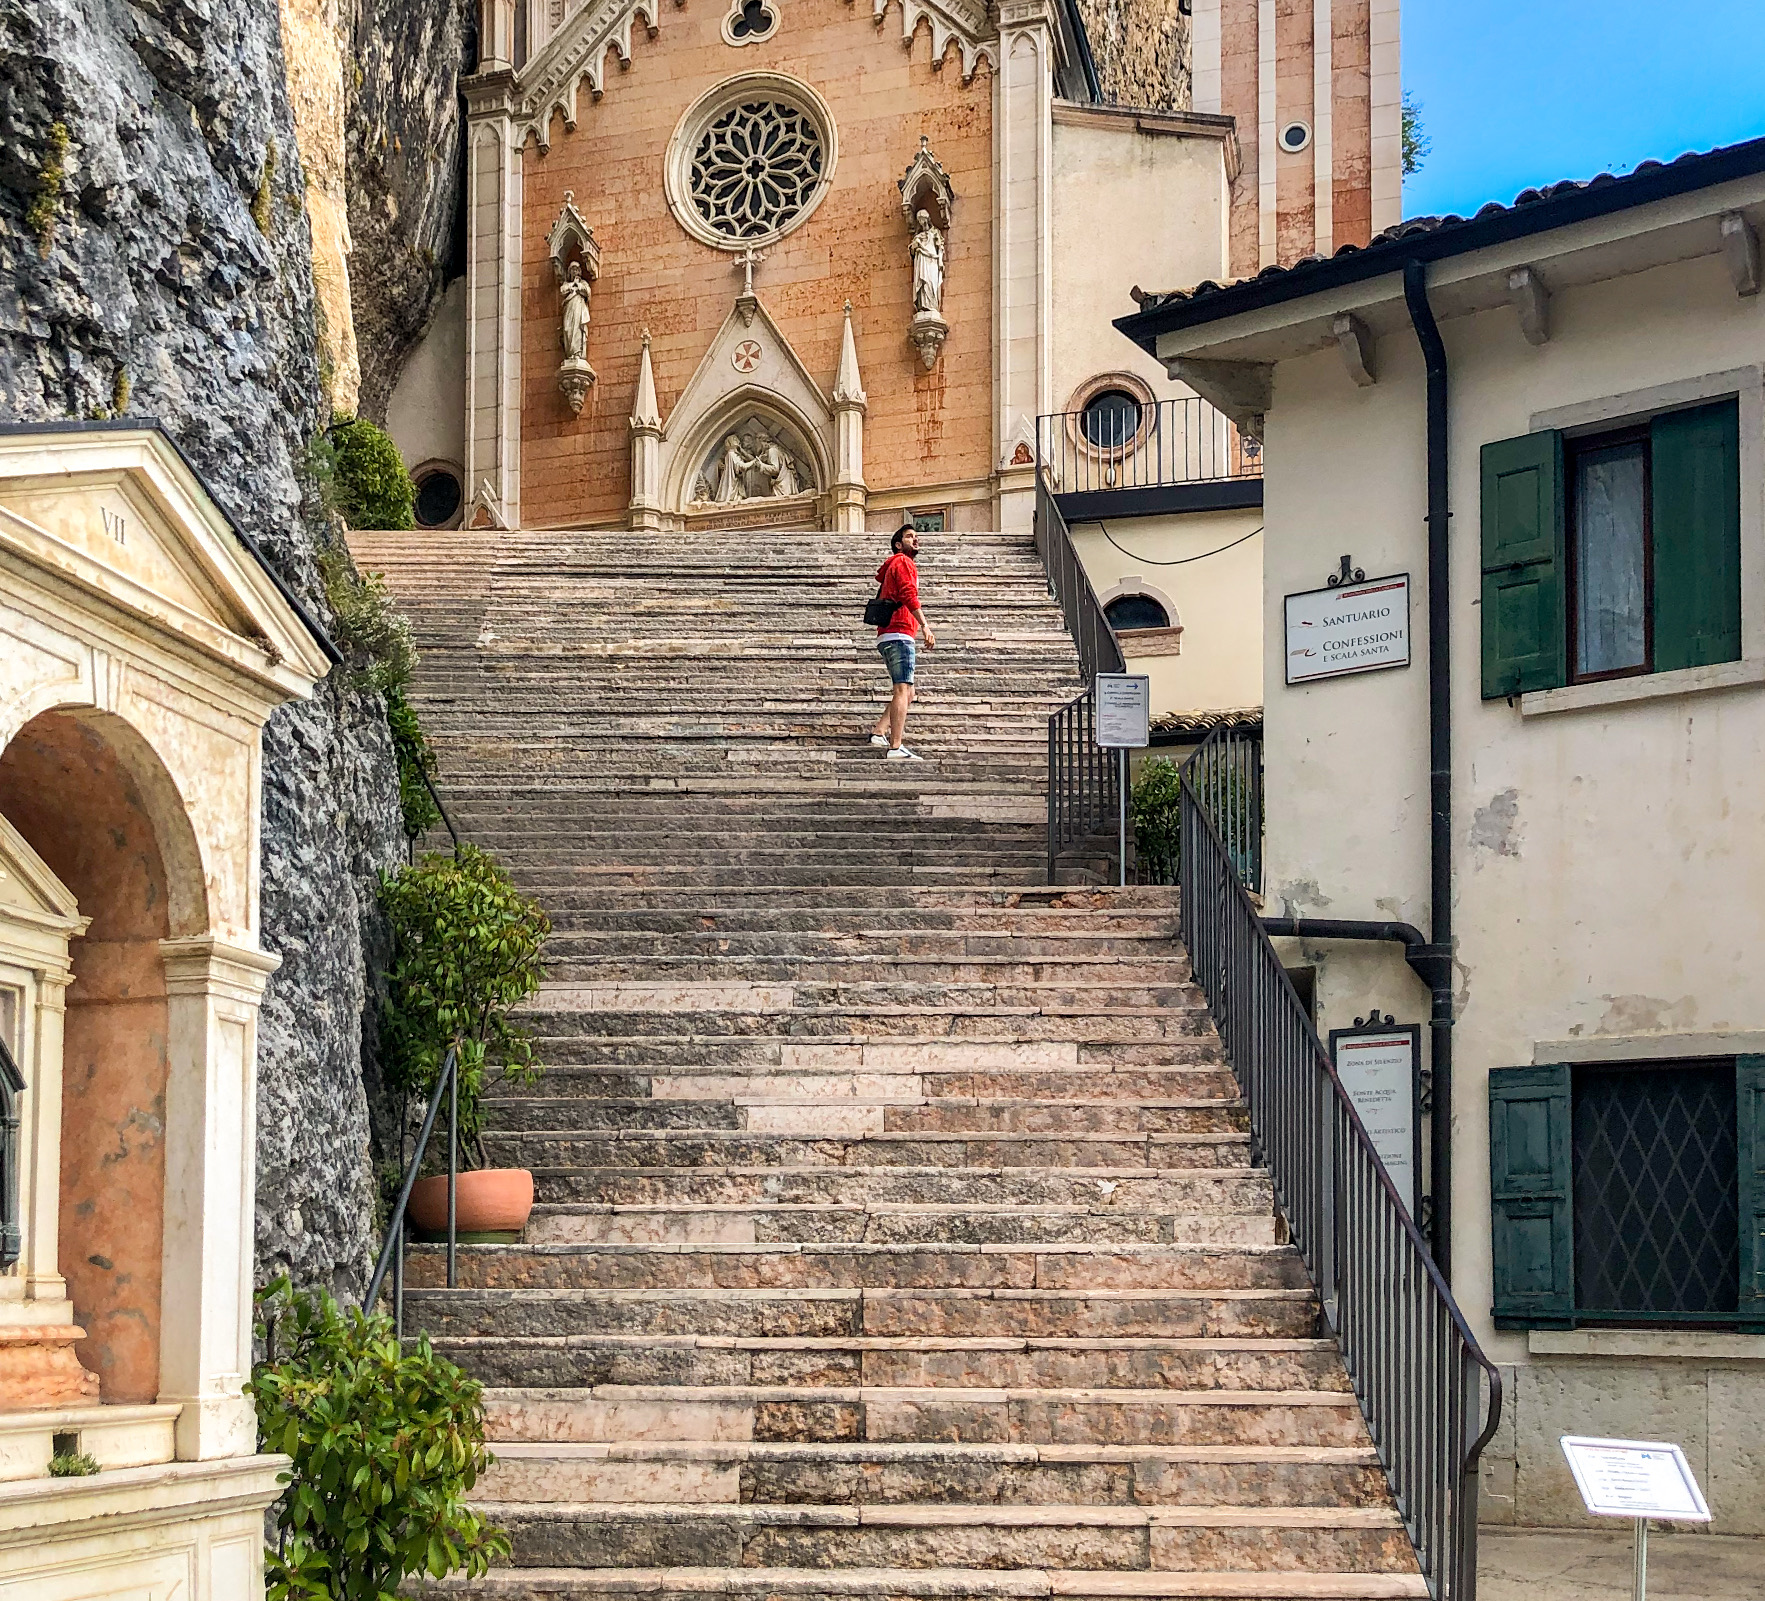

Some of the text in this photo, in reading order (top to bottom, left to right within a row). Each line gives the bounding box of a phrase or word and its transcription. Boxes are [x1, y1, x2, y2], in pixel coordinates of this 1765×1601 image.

[100, 506, 125, 545] VII
[1322, 607, 1390, 628] SANTUARIO
[1322, 629, 1403, 652] CONFESSIONI
[1330, 650, 1358, 661] SCALA
[1360, 645, 1390, 657] SANTA
